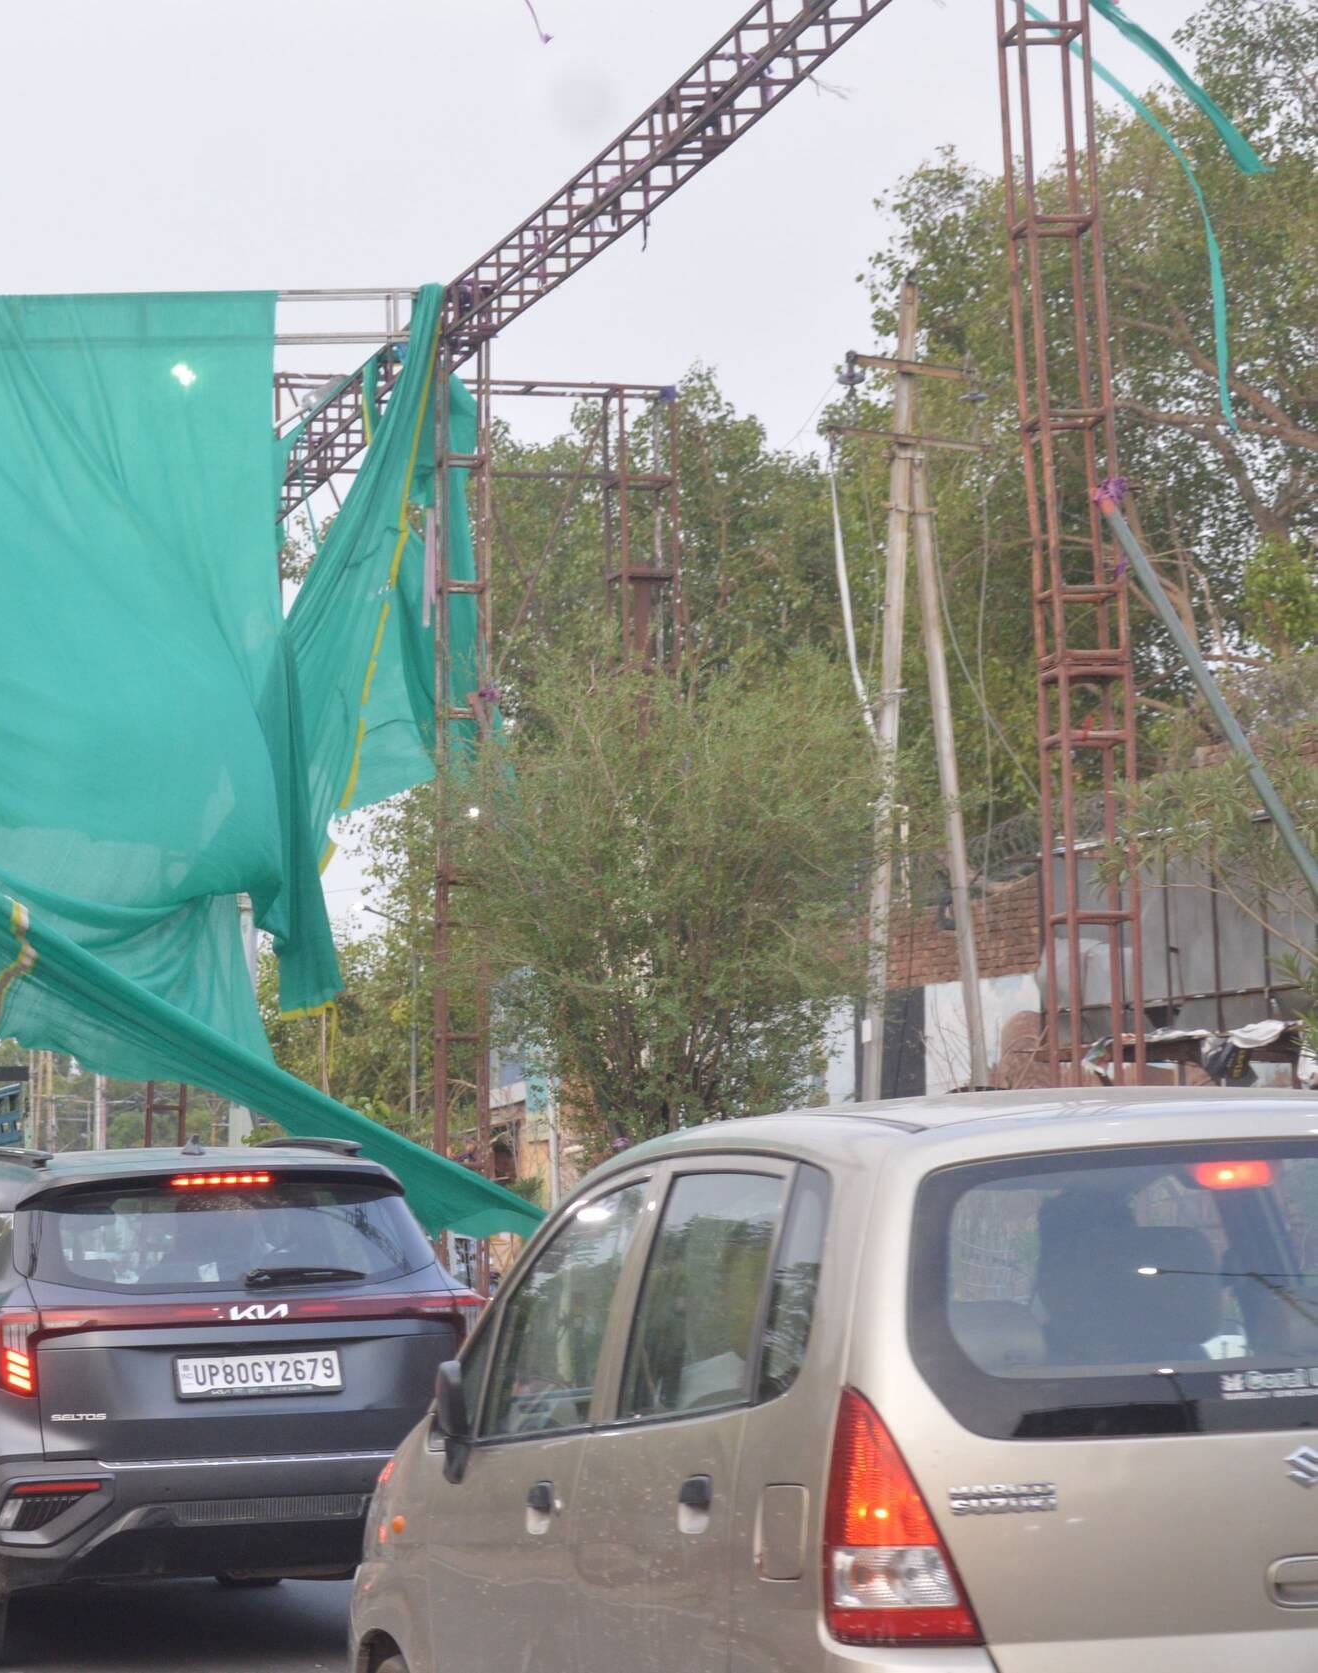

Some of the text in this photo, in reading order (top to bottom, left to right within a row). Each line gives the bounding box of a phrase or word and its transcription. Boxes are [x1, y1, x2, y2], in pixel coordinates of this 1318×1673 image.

[229, 1303, 289, 1321] KIA
[193, 1357, 336, 1386] UP80GY2679
[50, 1412, 107, 1422] SELTOS
[948, 1482, 1057, 1499] MARUTI
[949, 1496, 1058, 1516] SUZUKI
